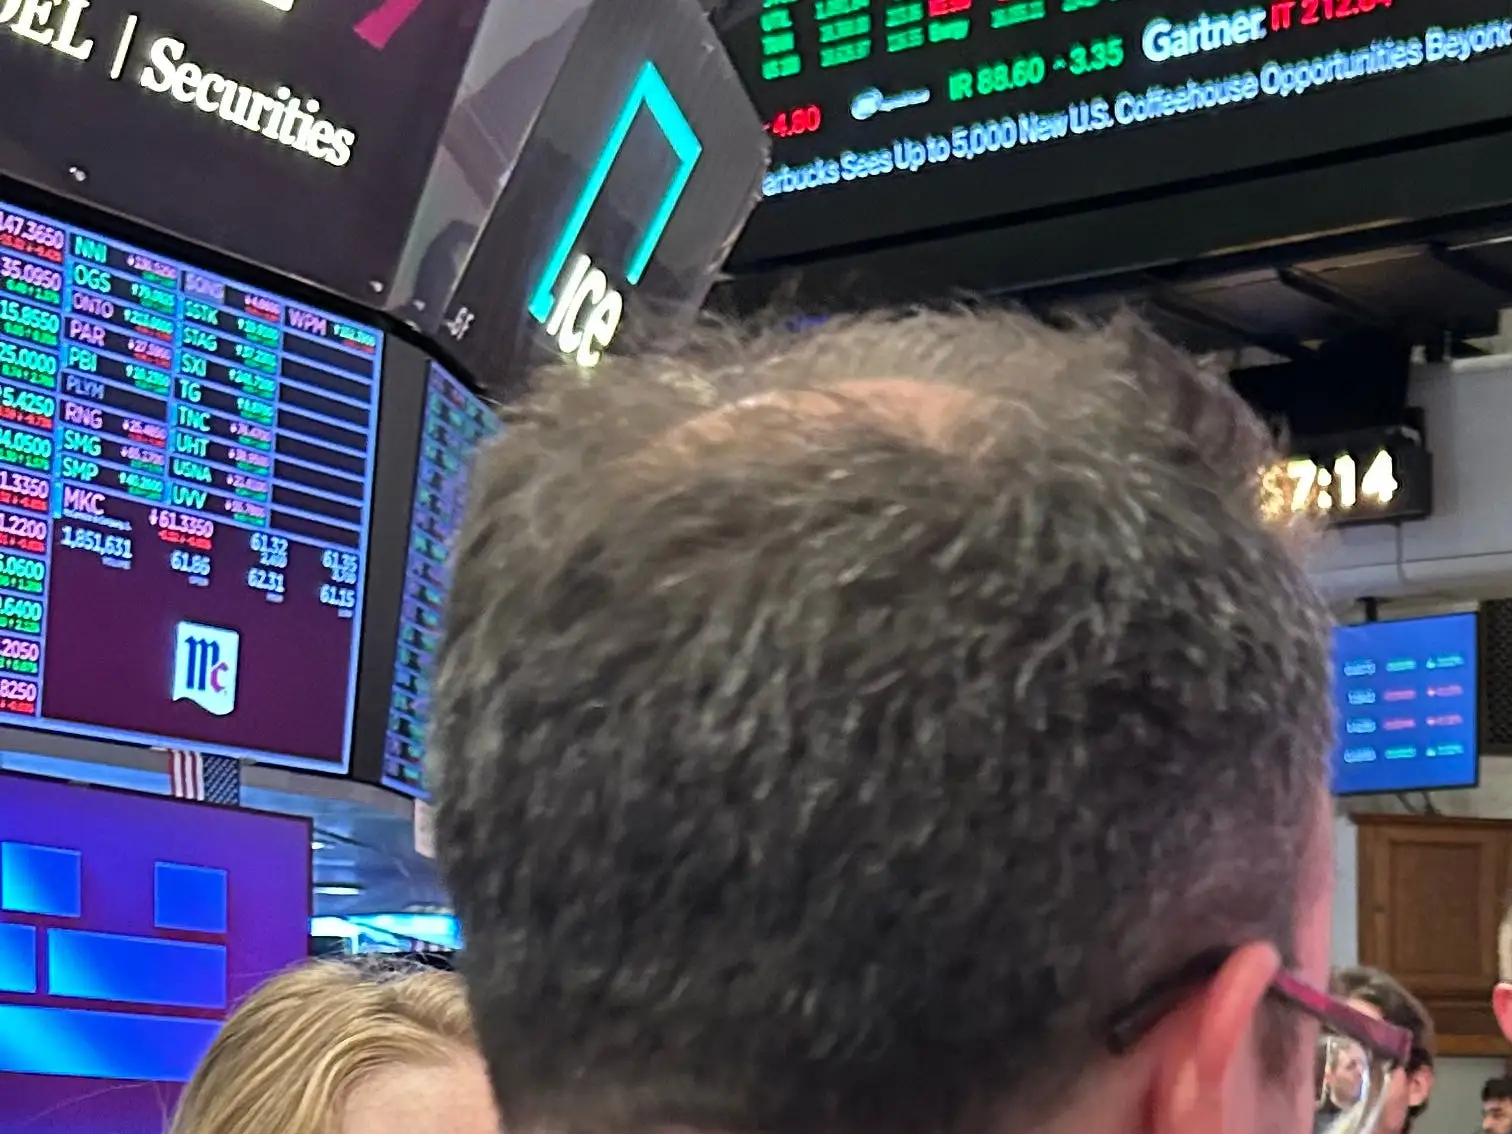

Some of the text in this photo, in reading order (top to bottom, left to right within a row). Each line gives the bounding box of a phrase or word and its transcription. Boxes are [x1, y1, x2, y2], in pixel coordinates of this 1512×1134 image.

[1300, 0, 1391, 24] 212.
[0, 0, 355, 167] EL Securities
[841, 149, 893, 180] Sees
[893, 138, 925, 172] Up
[926, 134, 950, 163] to
[951, 116, 1017, 160] 5,000
[1017, 111, 1067, 144] New
[1068, 96, 1114, 134] U.S.
[1114, 69, 1259, 125] Coffeehouse
[1260, 35, 1423, 97] Opportunities
[74, 264, 111, 293] OGS
[70, 319, 105, 347] PAR
[179, 379, 201, 402] TG
[64, 430, 101, 456] SMG
[62, 457, 99, 481] SMP
[64, 486, 106, 515] MKC
